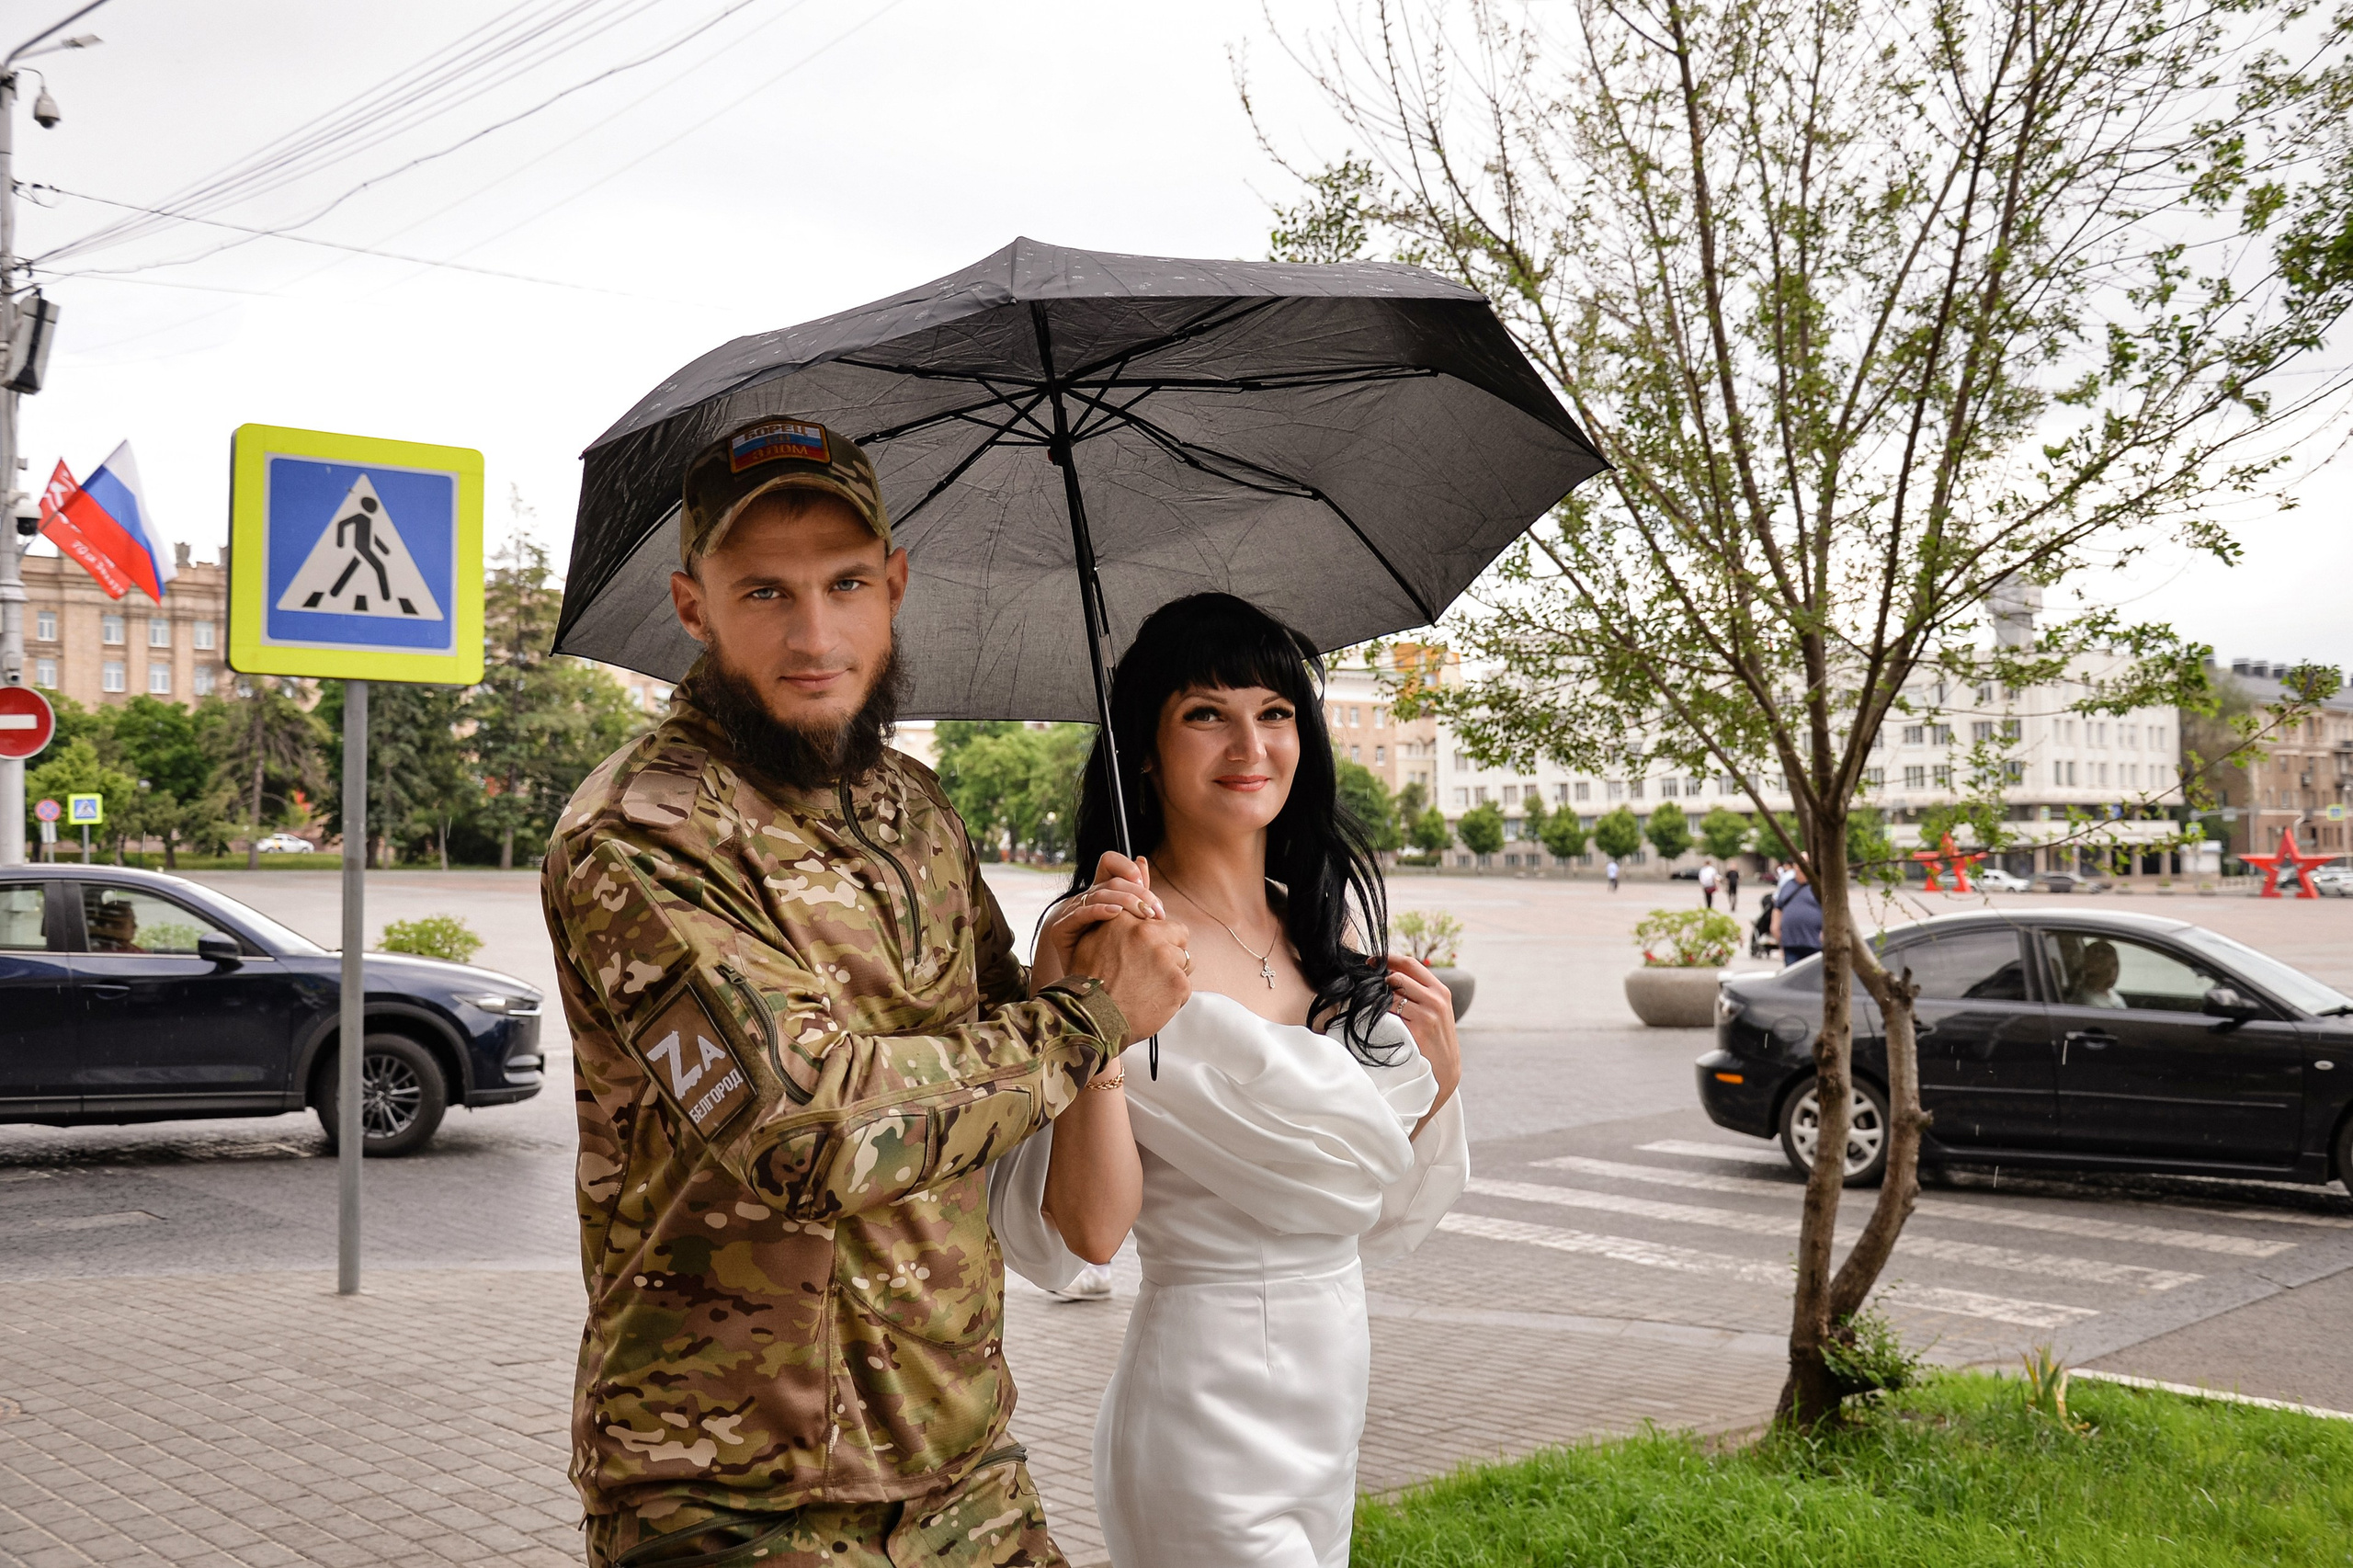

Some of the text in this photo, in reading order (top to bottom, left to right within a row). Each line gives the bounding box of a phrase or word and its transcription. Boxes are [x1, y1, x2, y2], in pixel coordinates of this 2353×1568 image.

[745, 424, 808, 441] БОРЕЦ
[752, 444, 809, 460] ЗЛОМ
[688, 1068, 744, 1124] БЕЛГОРОД
